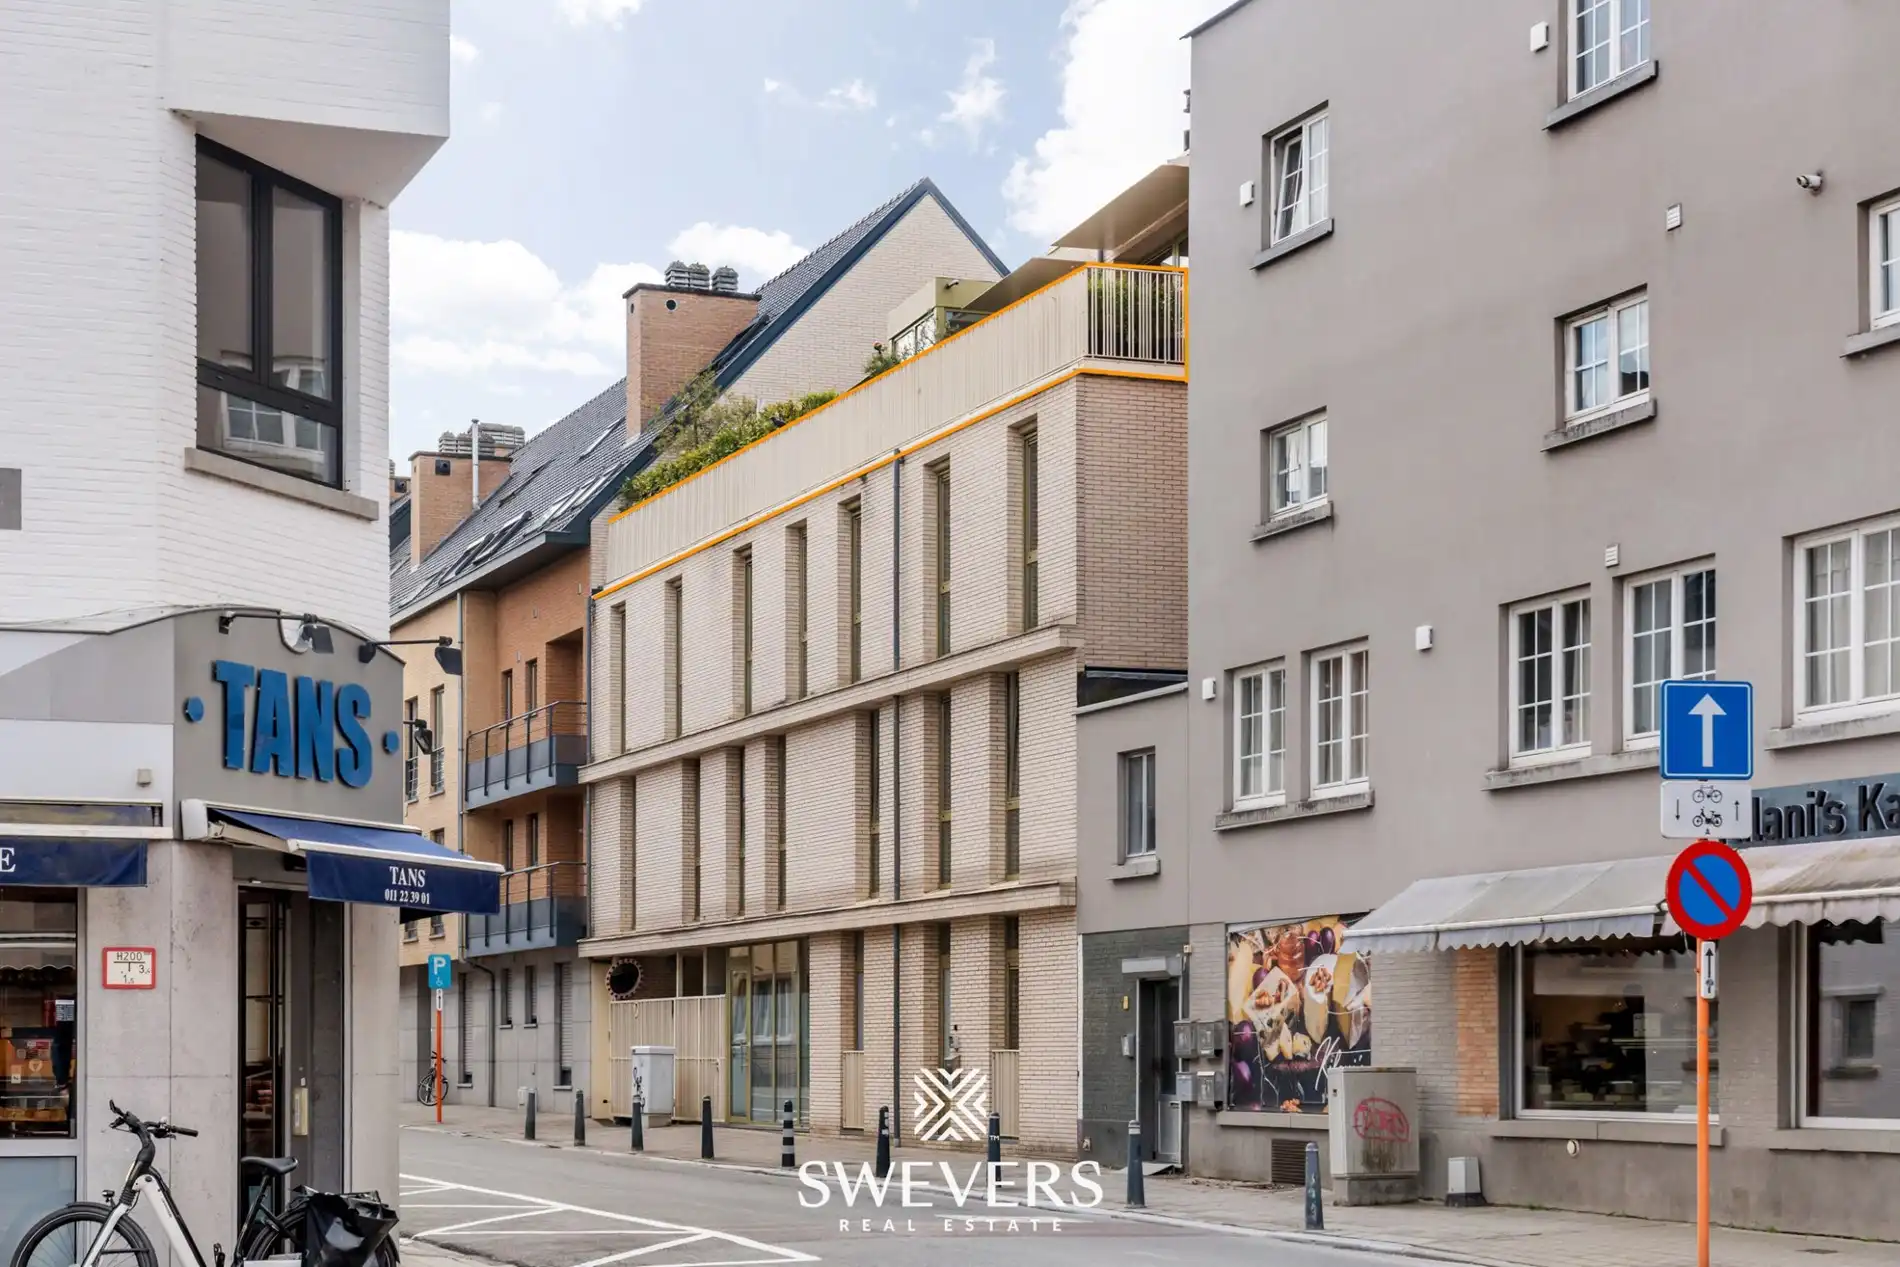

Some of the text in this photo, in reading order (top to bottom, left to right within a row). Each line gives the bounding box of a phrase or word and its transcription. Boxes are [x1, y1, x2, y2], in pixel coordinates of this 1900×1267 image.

[211, 659, 374, 788] TANS
[1751, 788, 1847, 842] lani's
[389, 866, 426, 888] TANS
[384, 888, 430, 905] 011 22 39 01
[116, 951, 143, 961] H200
[433, 956, 446, 975] P
